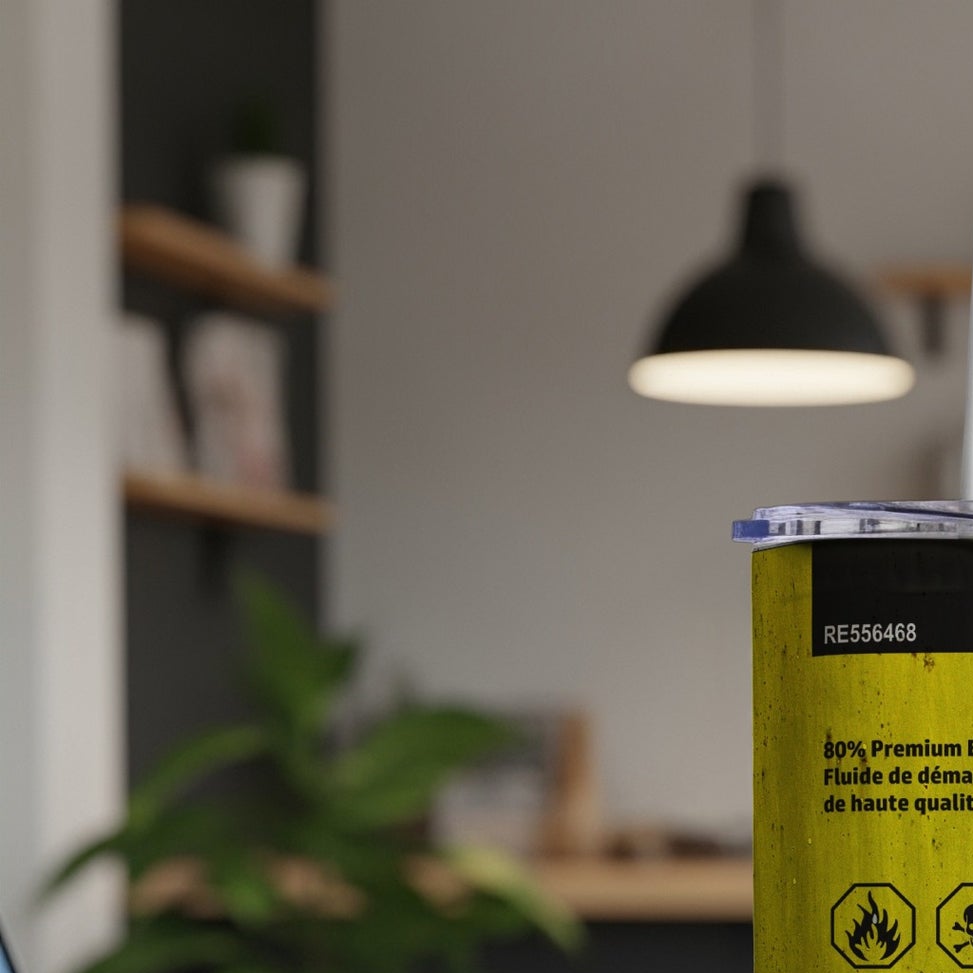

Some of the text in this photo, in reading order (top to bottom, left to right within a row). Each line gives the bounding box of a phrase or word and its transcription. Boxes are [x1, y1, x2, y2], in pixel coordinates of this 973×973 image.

[824, 623, 917, 645] RE556468
[824, 741, 866, 759] 80%
[871, 739, 962, 757] Premium
[824, 767, 883, 786] Fluide
[889, 767, 912, 784] de
[824, 795, 846, 813] de
[852, 794, 909, 813] haute
